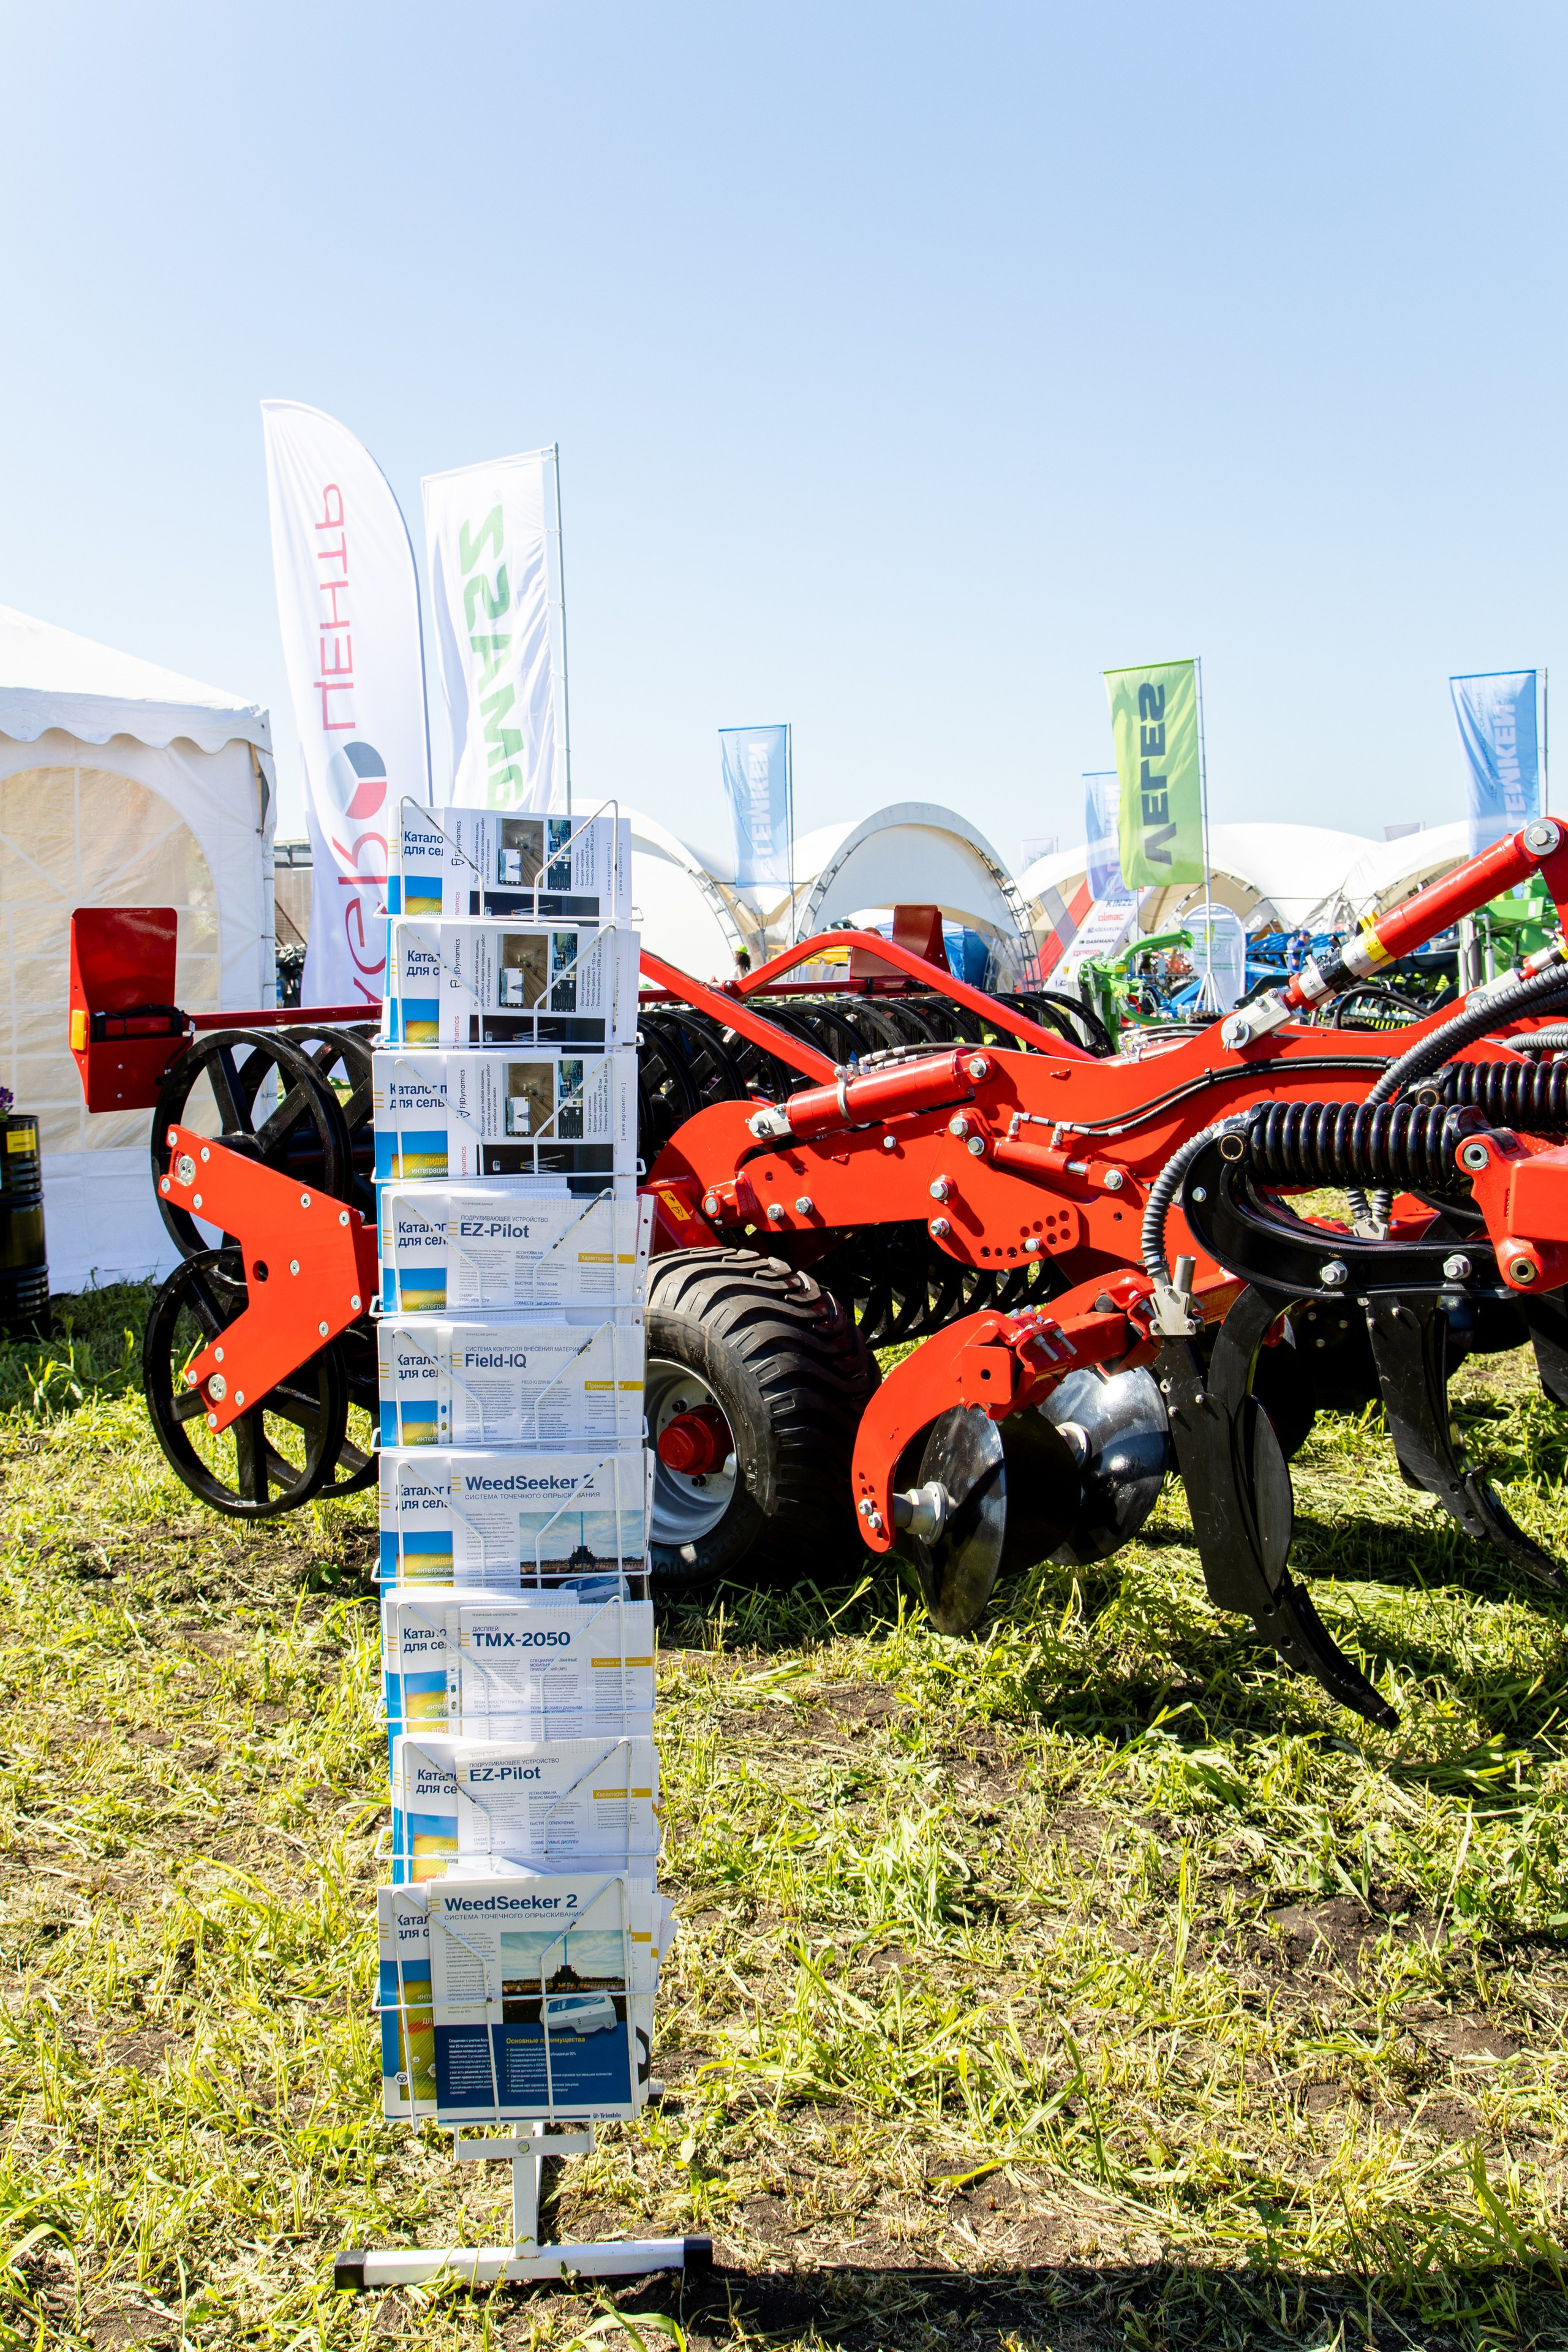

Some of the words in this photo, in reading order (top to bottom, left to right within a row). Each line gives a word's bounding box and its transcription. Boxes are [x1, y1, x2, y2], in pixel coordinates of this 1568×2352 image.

[404, 846, 425, 856] для
[407, 967, 429, 977] для
[459, 1069, 467, 1109] FJDynamics
[461, 1223, 529, 1238] EZ-Pilot
[398, 1237, 421, 1248] для
[465, 1354, 527, 1368] Field-IQ
[466, 1475, 578, 1490] WeedSeeker
[472, 1632, 571, 1647] TMX-2050
[404, 1643, 427, 1653] для
[469, 1759, 521, 1768] ПОДРУЛИВАЮЩЕЕ
[470, 1766, 541, 1782] EZ-Pilot
[416, 1785, 440, 1795] для
[444, 1894, 561, 1911] WeedSeeker
[567, 1894, 578, 1908] 2
